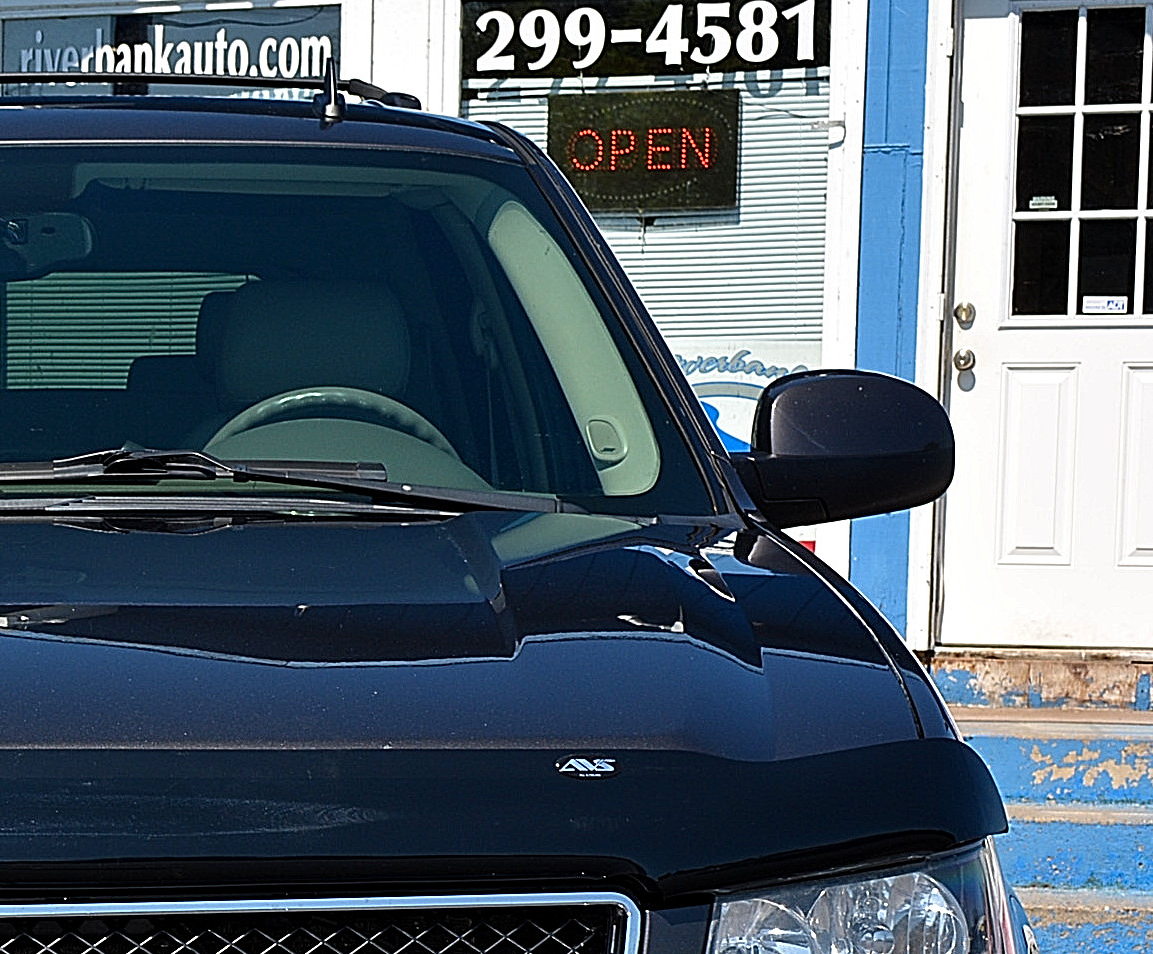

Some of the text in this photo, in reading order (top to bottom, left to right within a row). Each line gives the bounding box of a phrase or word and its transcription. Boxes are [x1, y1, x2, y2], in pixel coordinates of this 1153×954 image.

[20, 24, 332, 80] riverbankauto.com
[475, 0, 816, 71] 299-4581
[568, 127, 712, 172] OPEN
[559, 758, 616, 772] AVS
